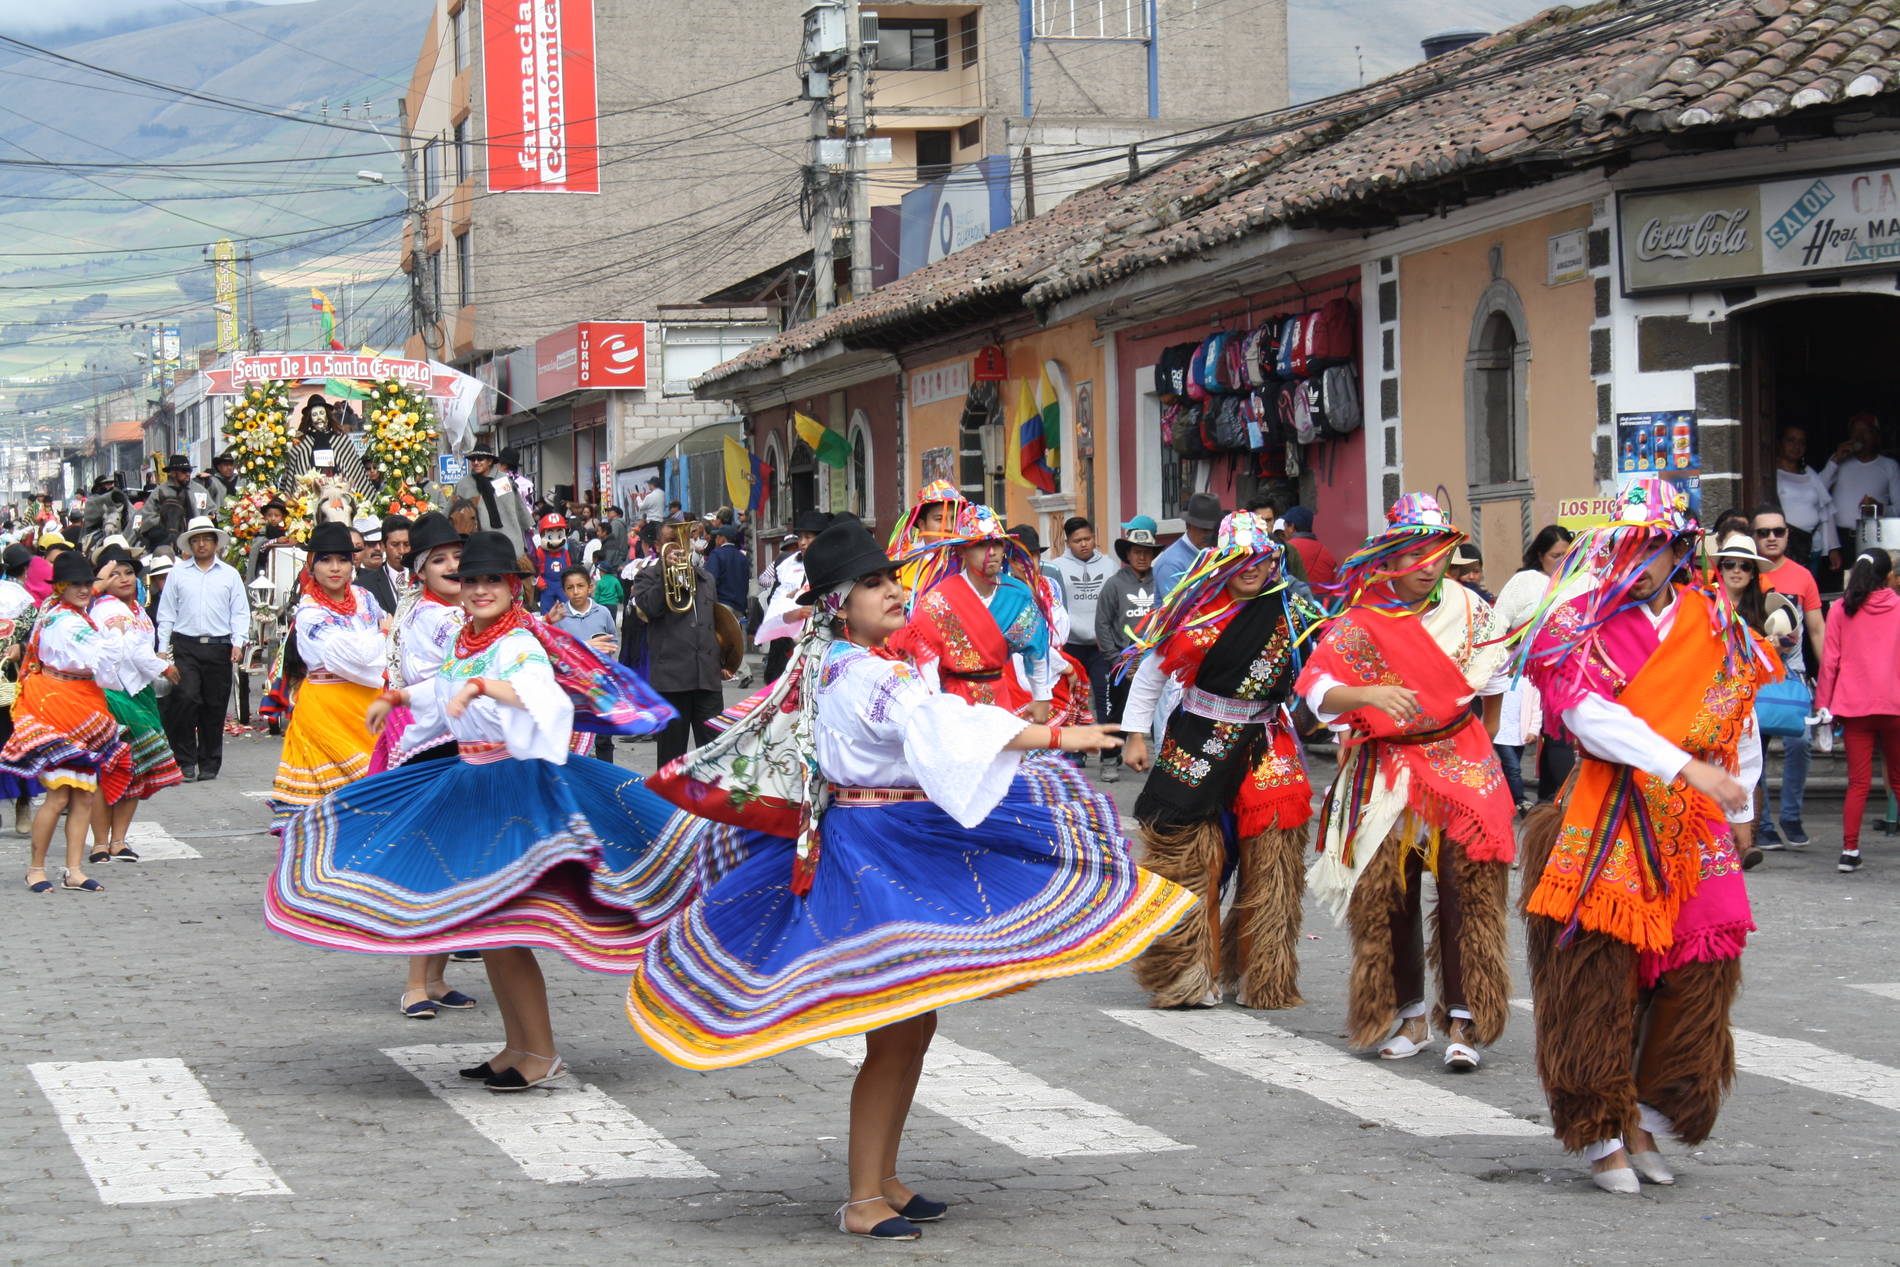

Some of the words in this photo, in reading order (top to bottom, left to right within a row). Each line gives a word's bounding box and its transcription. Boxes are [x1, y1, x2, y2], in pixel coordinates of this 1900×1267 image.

[515, 1, 538, 171] farmacia
[1636, 208, 1750, 262] Coca-Cola
[1768, 182, 1834, 248] SALON
[234, 359, 277, 380] Señor
[281, 357, 299, 377] De
[323, 356, 368, 377] Santa
[370, 358, 430, 382] Escuela
[581, 330, 590, 381] TURNO
[1560, 500, 1589, 517] LOS
[1126, 607, 1150, 617] adid
